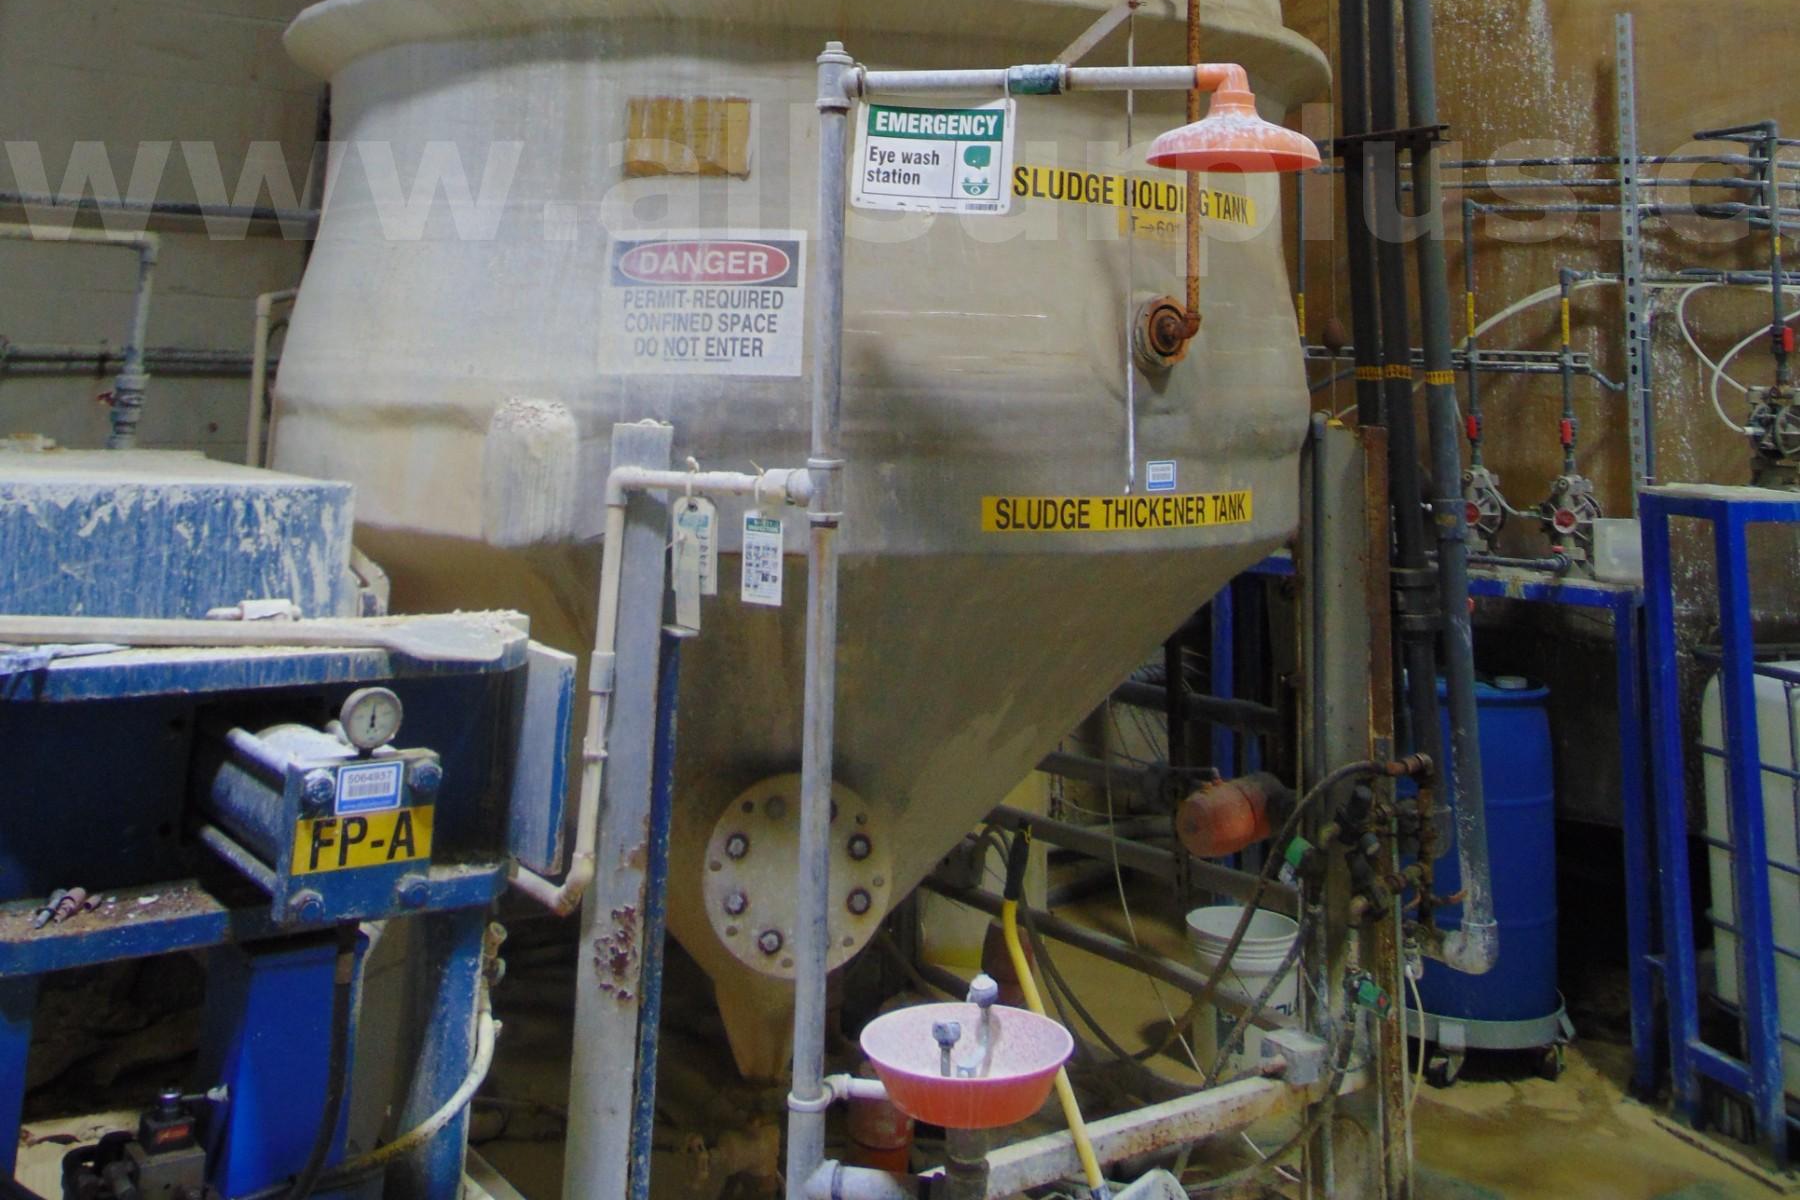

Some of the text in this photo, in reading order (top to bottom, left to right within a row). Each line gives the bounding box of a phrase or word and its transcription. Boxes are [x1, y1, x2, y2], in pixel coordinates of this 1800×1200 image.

[875, 110, 998, 136] EMERGENCY
[869, 145, 940, 166] Eye wash
[866, 167, 921, 185] station
[1013, 166, 1249, 224] SLUDGE HOLDIG TANK
[638, 251, 769, 275] DANGER
[623, 289, 784, 310] PERMIT-REQUIRED
[624, 313, 778, 334] CONFINED SPACE
[634, 337, 764, 357] DO NOT ENTER
[995, 493, 1246, 530] SLUDGE THICKENER TANK
[309, 810, 416, 870] FP-A
